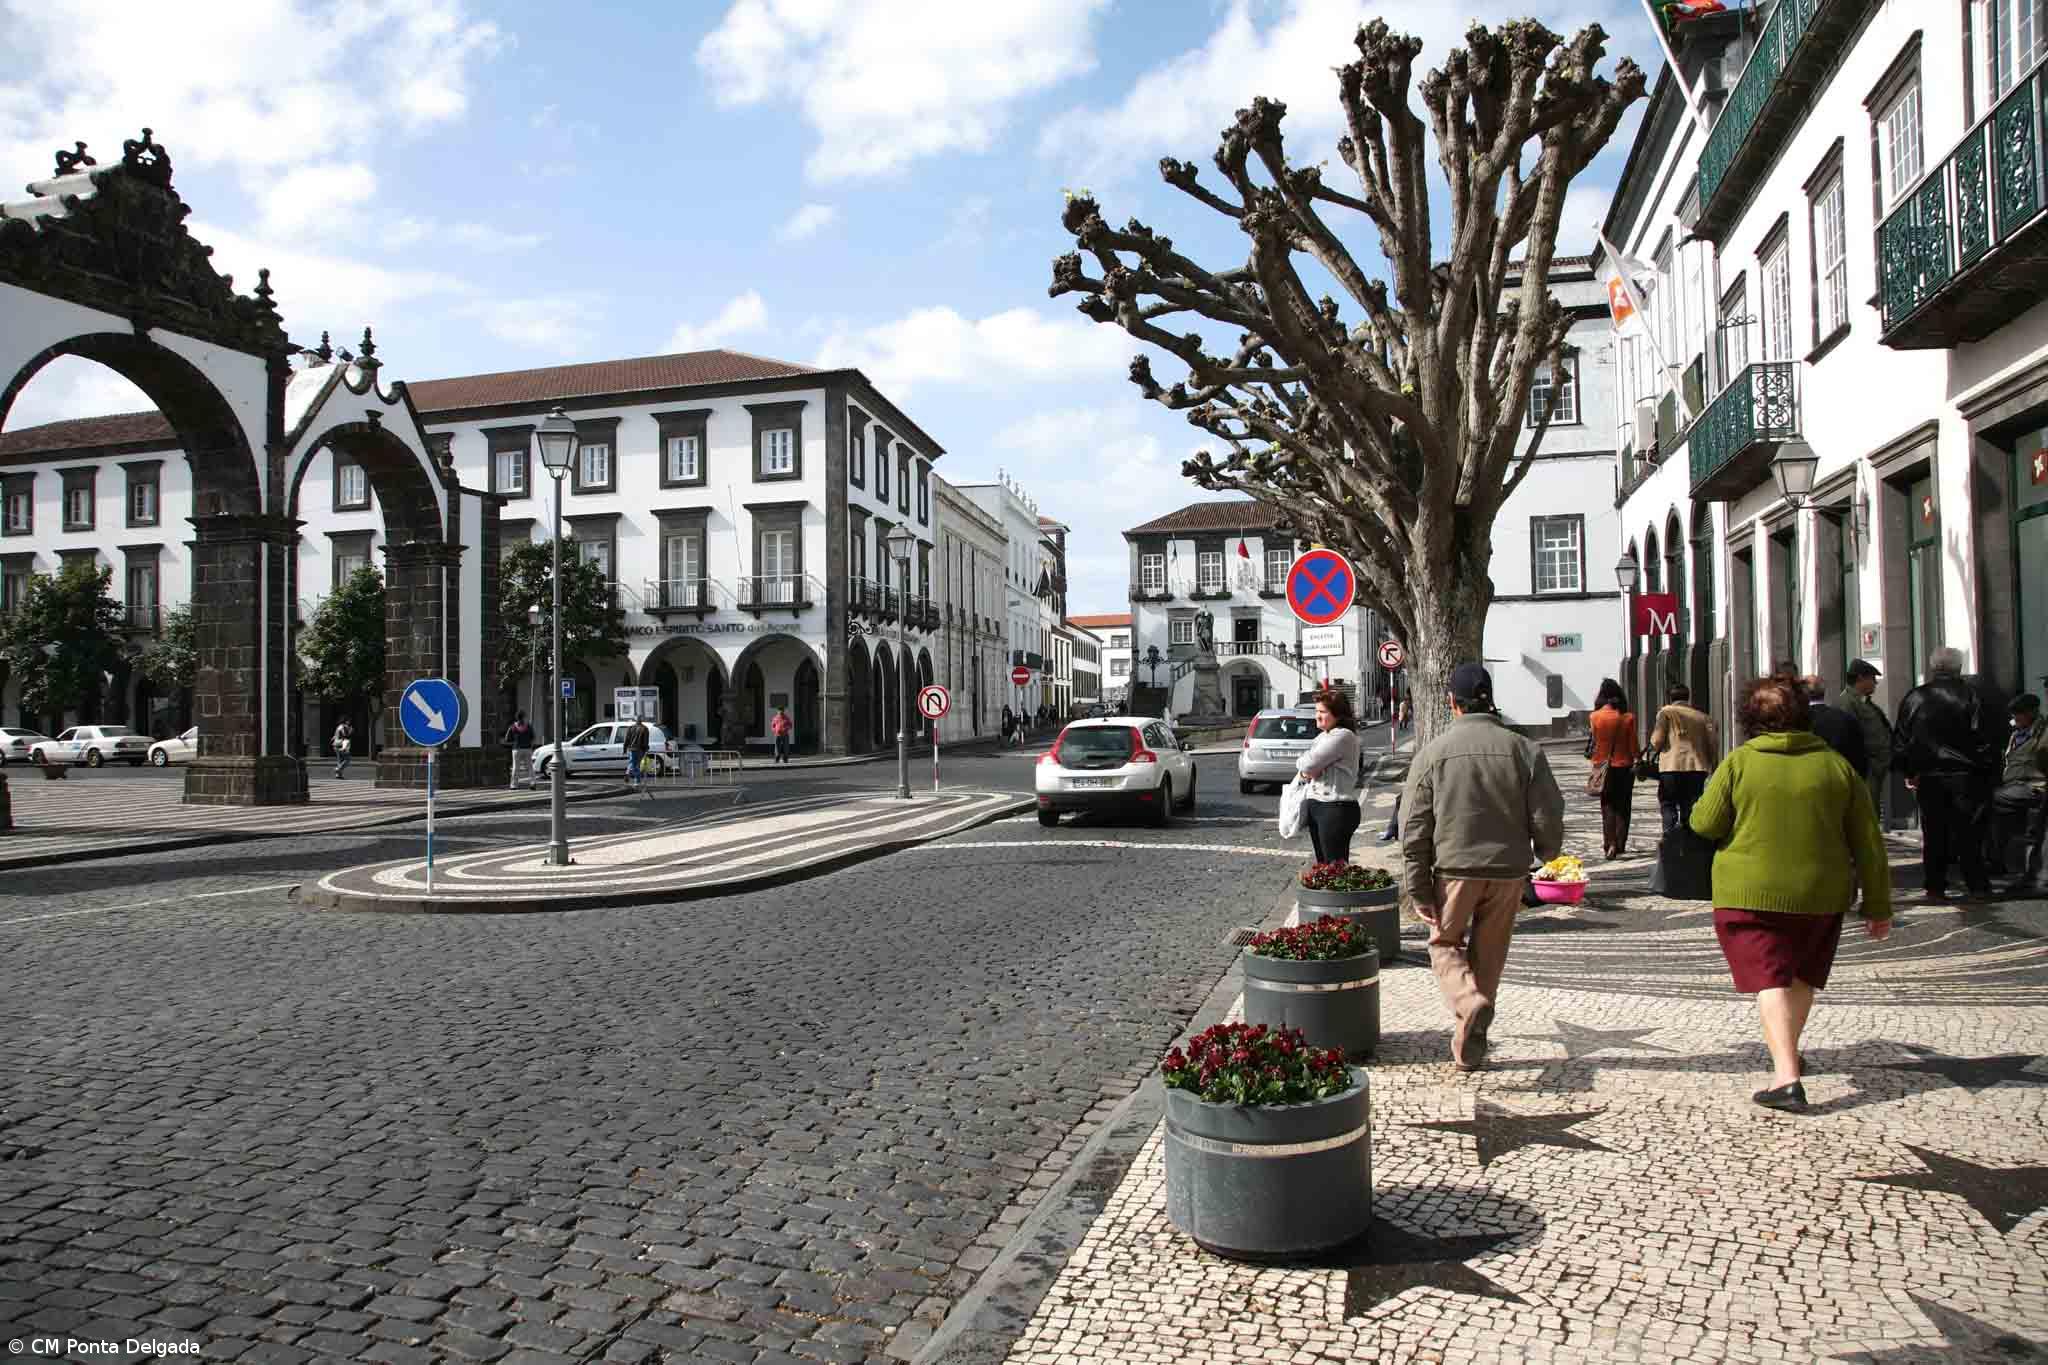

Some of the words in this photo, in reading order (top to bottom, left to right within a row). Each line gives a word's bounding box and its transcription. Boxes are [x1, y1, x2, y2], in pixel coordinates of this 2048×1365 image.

[1647, 607, 1678, 635] M
[707, 623, 745, 633] SANTO
[1558, 636, 1575, 647] BPI
[561, 681, 571, 697] P
